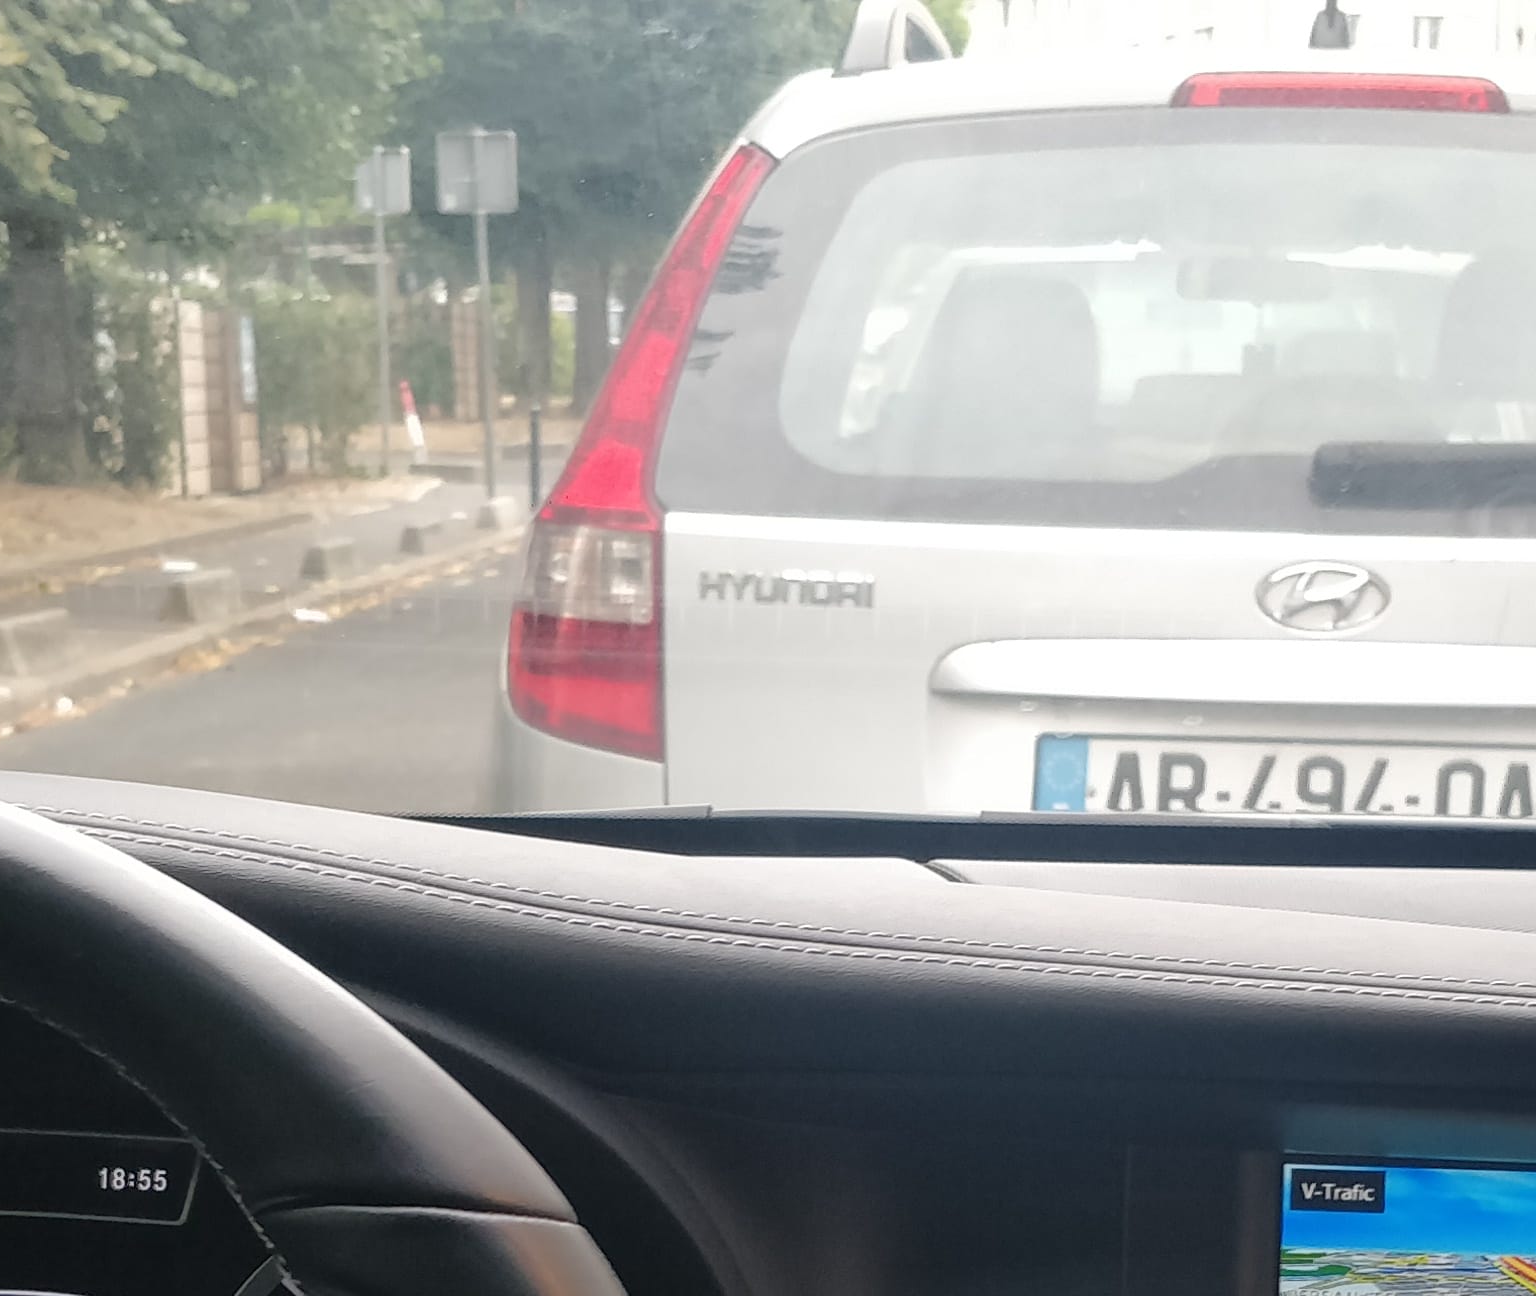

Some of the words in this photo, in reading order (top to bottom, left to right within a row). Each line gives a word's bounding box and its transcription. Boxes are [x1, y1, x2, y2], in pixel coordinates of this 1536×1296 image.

[697, 568, 876, 609] HYUNDAI
[97, 1167, 168, 1192] 18:55
[1300, 1182, 1376, 1202] V-Trafic
